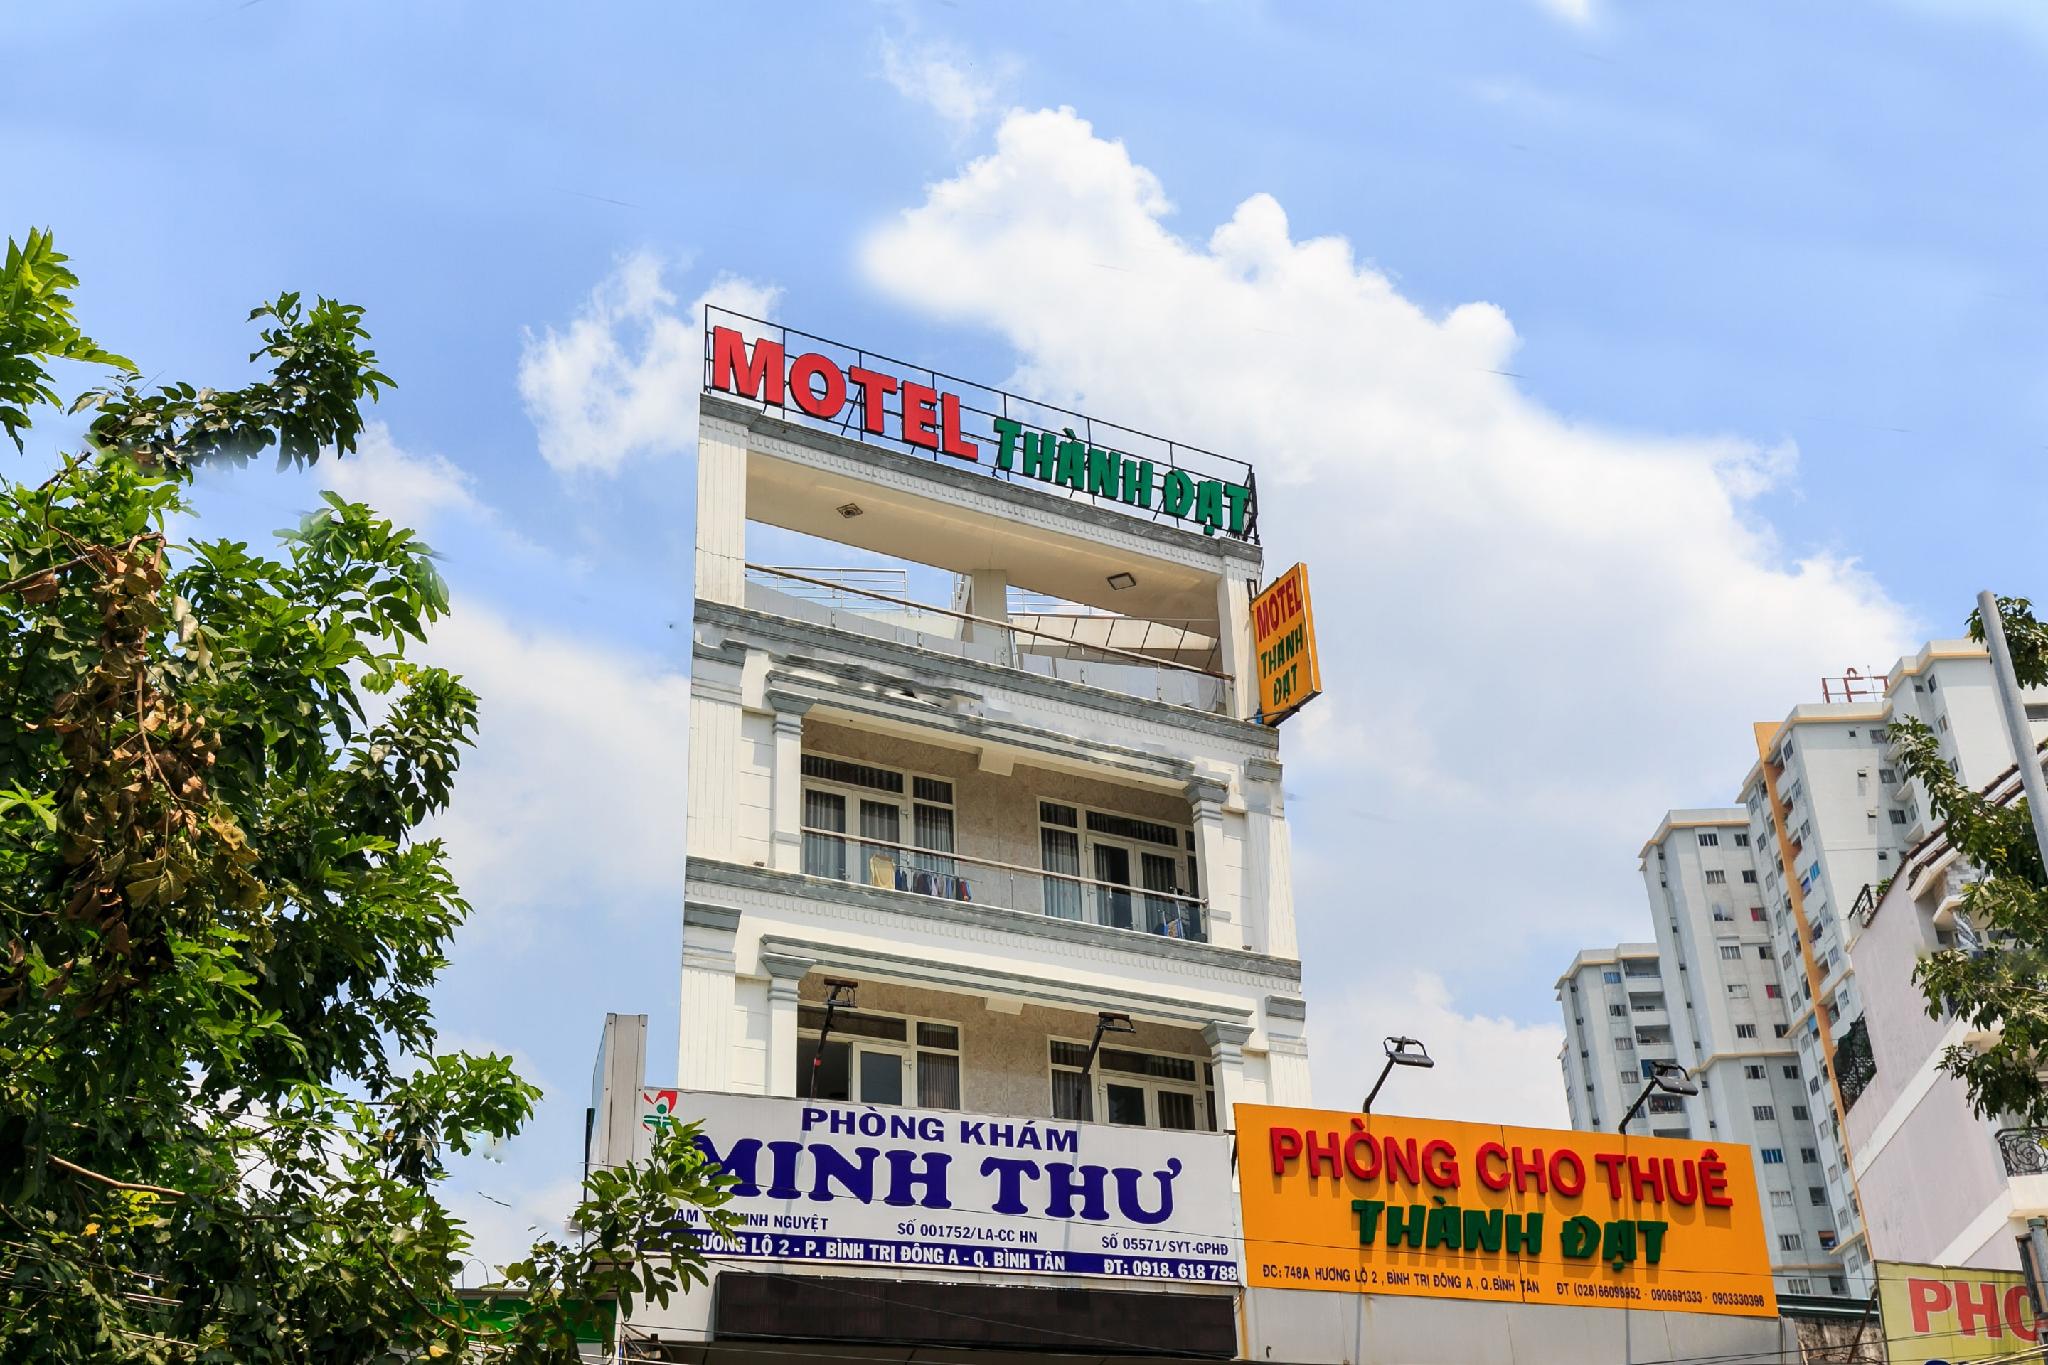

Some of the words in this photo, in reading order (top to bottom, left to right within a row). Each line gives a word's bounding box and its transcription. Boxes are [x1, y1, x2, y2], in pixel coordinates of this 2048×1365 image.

[713, 325, 978, 462] MOTEL
[993, 416, 1153, 509] THÀNH
[1163, 469, 1250, 536] ĐẠT
[1256, 575, 1301, 643] MOTEL
[1261, 623, 1303, 679] THÀNH
[1273, 662, 1297, 706] ĐẠT
[802, 1106, 945, 1143] PHÒNG
[960, 1120, 1078, 1153] KHÁM
[691, 1134, 952, 1209] MINH
[980, 1156, 1182, 1225] THƯ
[1270, 1118, 1461, 1189] PHÒNG
[1476, 1142, 1586, 1198] CHO
[1595, 1148, 1733, 1208] THUÊ
[774, 1213, 829, 1233] NGUYỆT
[897, 1218, 916, 1236] SỐ
[920, 1224, 1015, 1242] 001752/LA-CC
[1020, 1230, 1038, 1243] HN
[1101, 1232, 1119, 1249] SỐ
[1123, 1237, 1229, 1256] 05571/SYT-GPHĐ
[1351, 1196, 1544, 1255] THÀNH
[1560, 1215, 1668, 1272] ĐẠT
[751, 1234, 773, 1257] LỘ
[778, 1240, 789, 1255] 2
[805, 1241, 821, 1257] P.
[826, 1237, 864, 1259] BÌNH
[869, 1244, 896, 1264] TRỊ
[900, 1242, 944, 1264] ĐÔNG
[948, 1249, 959, 1264] A
[973, 1251, 988, 1268] Q.
[994, 1248, 1030, 1269] BÌNH
[1034, 1251, 1066, 1271] TÂN
[1104, 1258, 1128, 1275] ĐT:
[1132, 1260, 1174, 1278] 0918.
[1178, 1263, 1206, 1280] 618
[1210, 1265, 1238, 1281] 788
[1263, 1264, 1282, 1278] ĐC:
[1284, 1265, 1310, 1281] 748A
[1355, 1267, 1368, 1285] LỘ
[1387, 1269, 1410, 1285] BÌNH
[1414, 1273, 1430, 1288] TRỊ
[1433, 1272, 1462, 1288] ĐÔNG
[1520, 1278, 1540, 1293] TÂN
[1556, 1282, 1569, 1295] ĐT
